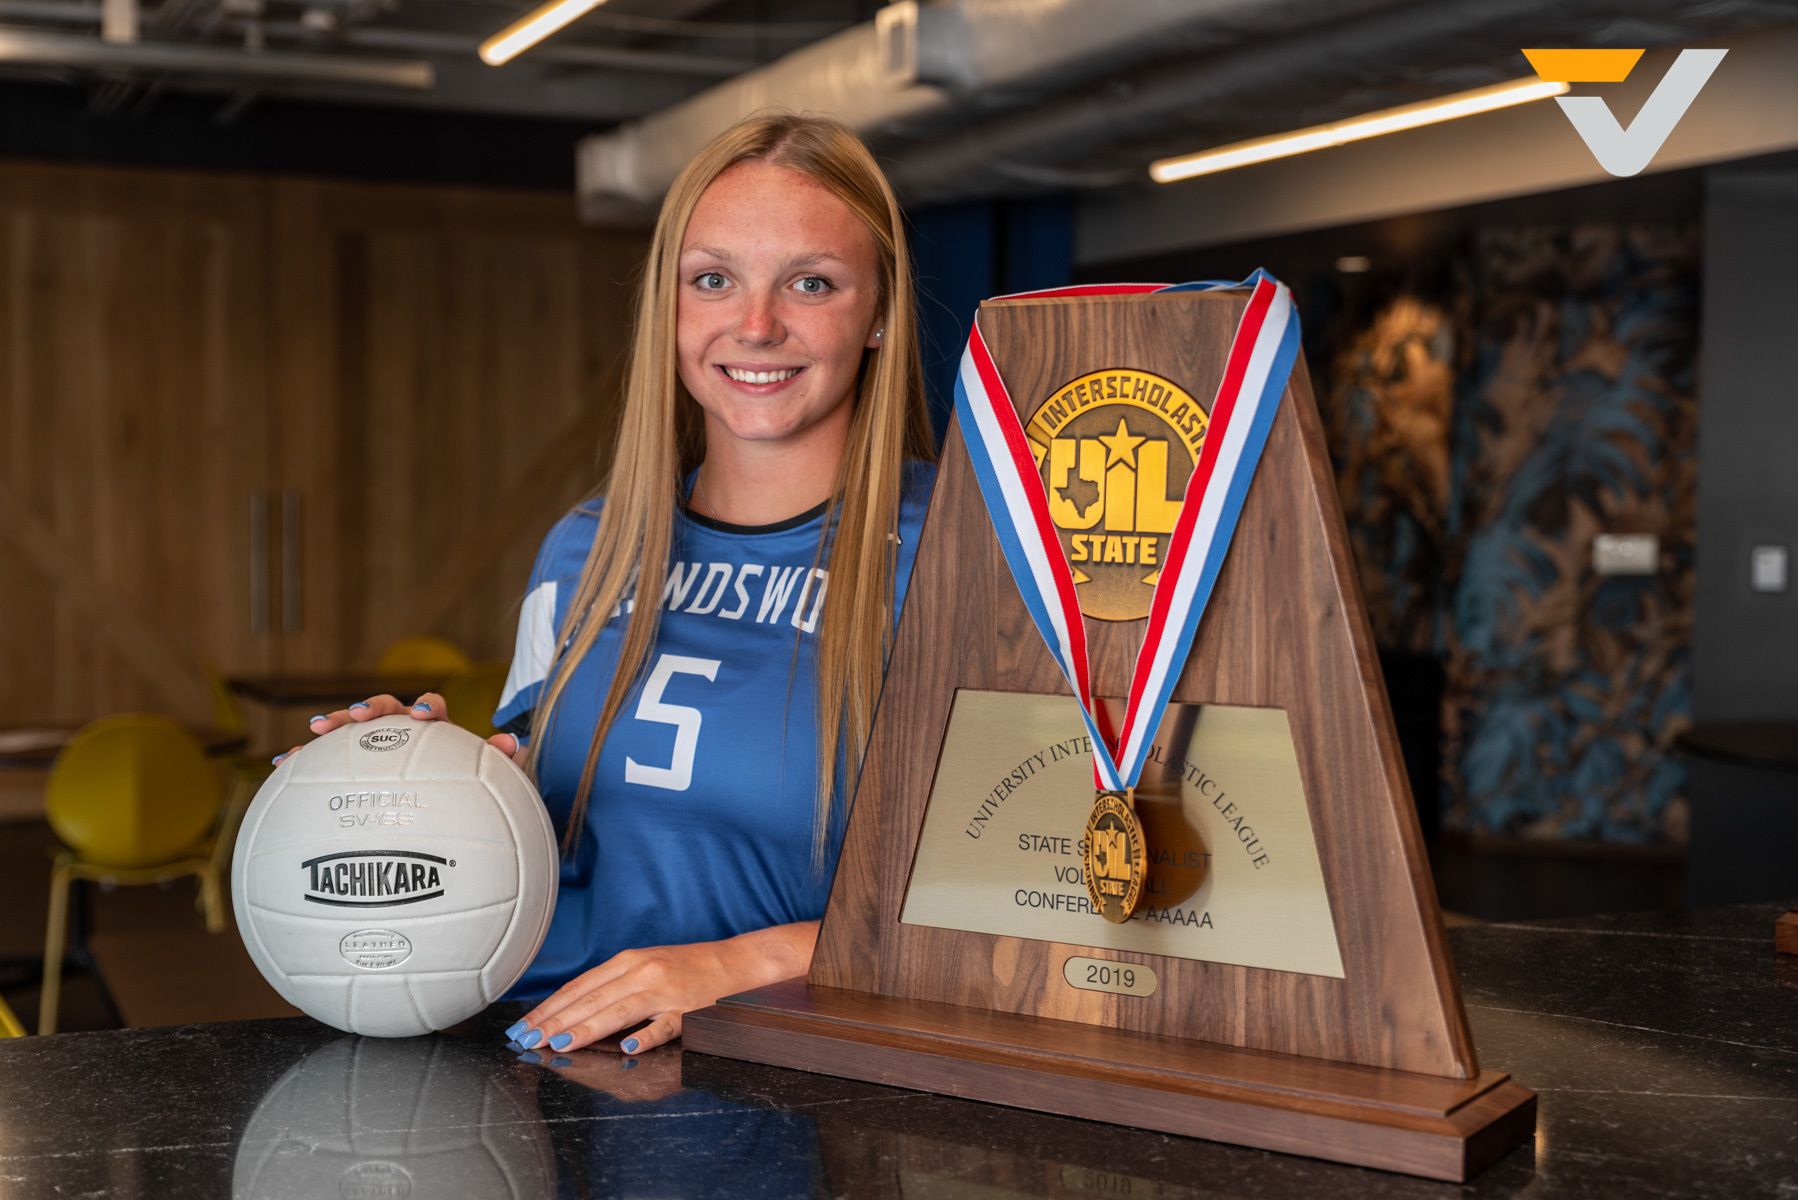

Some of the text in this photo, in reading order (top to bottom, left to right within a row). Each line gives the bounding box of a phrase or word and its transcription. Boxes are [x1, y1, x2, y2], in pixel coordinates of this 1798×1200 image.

[1041, 376, 1207, 455] INTERSCHOLAST
[1071, 534, 1158, 565] STATE
[624, 653, 722, 791] 5
[371, 735, 398, 743] SUC
[329, 791, 428, 811] OFFICIAL
[966, 751, 1046, 840] UNIVERSITY
[1212, 792, 1271, 870] LEAGUE
[1018, 833, 1072, 855] STATE
[303, 852, 442, 897] TACHIKARA
[1100, 880, 1125, 897] STATE
[1145, 905, 1214, 929] AAAAA
[345, 940, 406, 949] LEATHER
[1086, 965, 1136, 988] 2019
